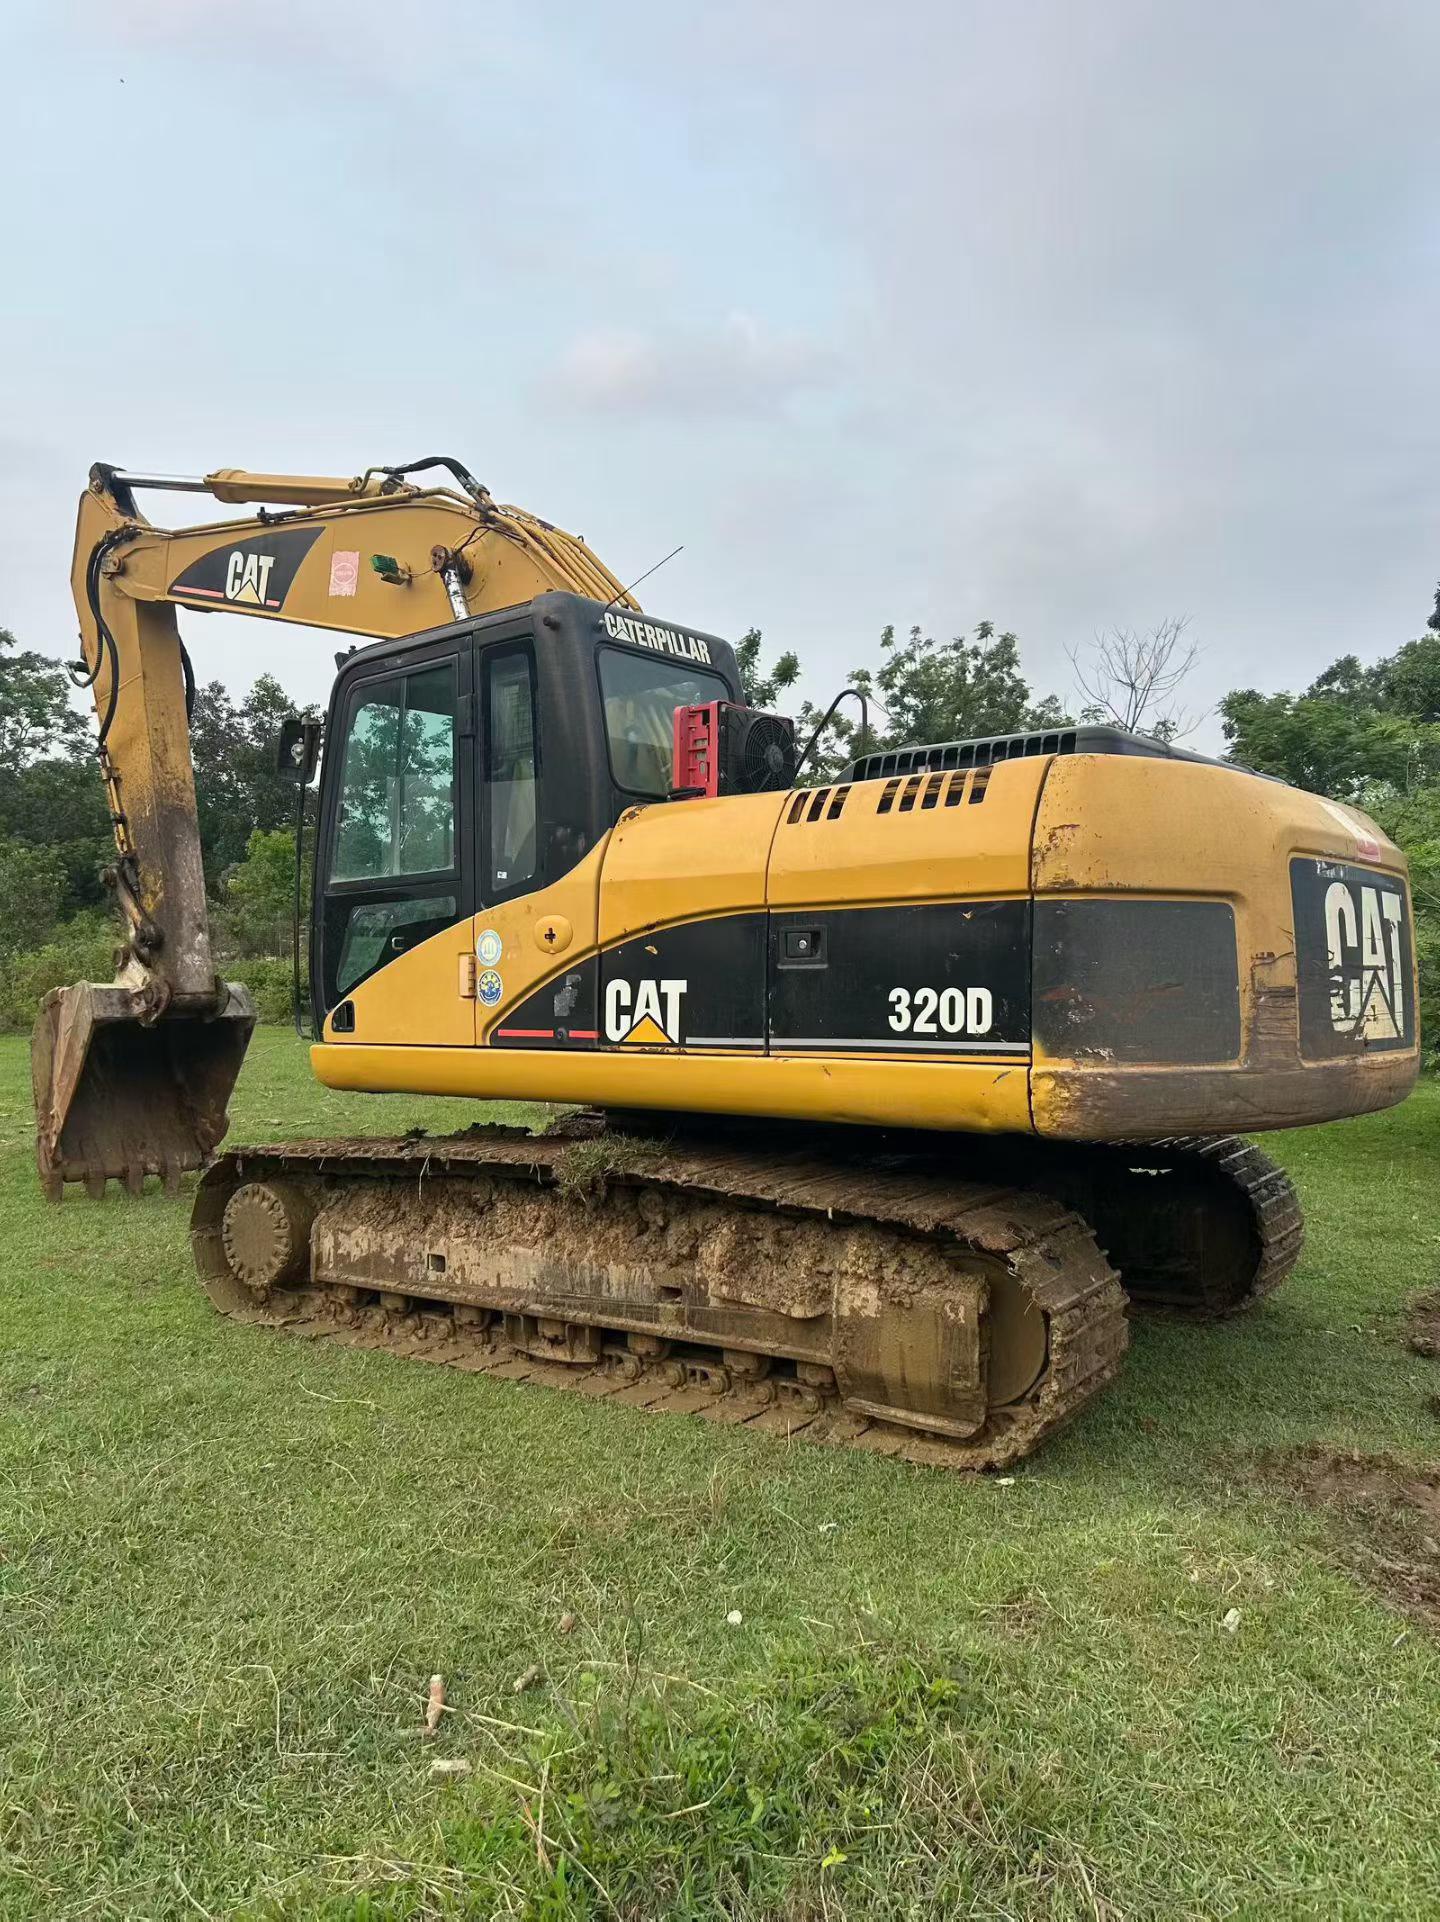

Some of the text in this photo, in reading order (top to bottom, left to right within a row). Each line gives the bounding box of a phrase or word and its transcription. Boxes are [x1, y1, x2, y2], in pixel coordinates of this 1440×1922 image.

[225, 551, 276, 605] CAT
[604, 612, 712, 665] CATERPILLAR
[1325, 882, 1404, 1039] CAT
[605, 979, 687, 1044] CAT
[888, 987, 992, 1034] 320D
